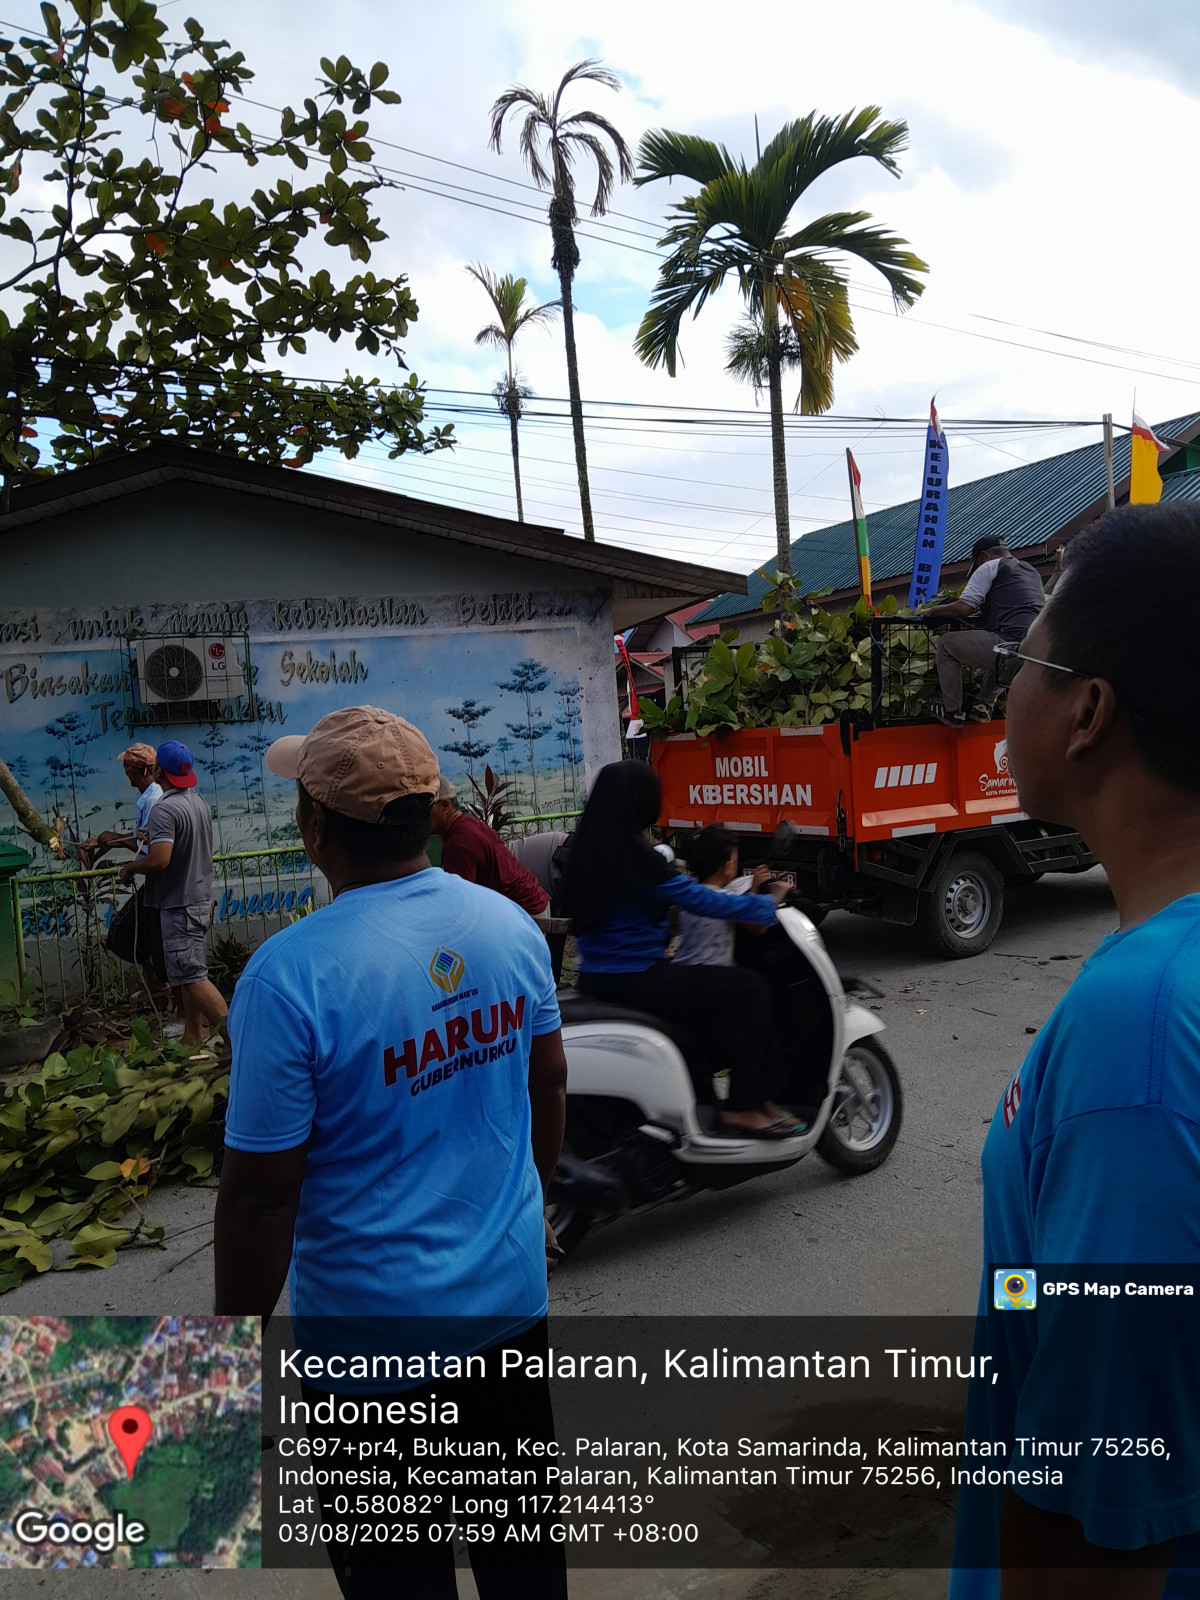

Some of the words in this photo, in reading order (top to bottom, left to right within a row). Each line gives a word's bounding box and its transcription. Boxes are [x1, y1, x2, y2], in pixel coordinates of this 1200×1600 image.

[922, 440, 944, 548] KELURAHAN
[68, 608, 146, 641] untuk
[166, 603, 249, 635] menuju
[275, 597, 428, 629] keberhasilan
[211, 661, 226, 671] LG
[280, 650, 368, 687] Sekolah
[715, 755, 769, 778] MOBIL
[383, 995, 526, 1087] HARUN
[410, 1037, 518, 1097] GUBERNURKU
